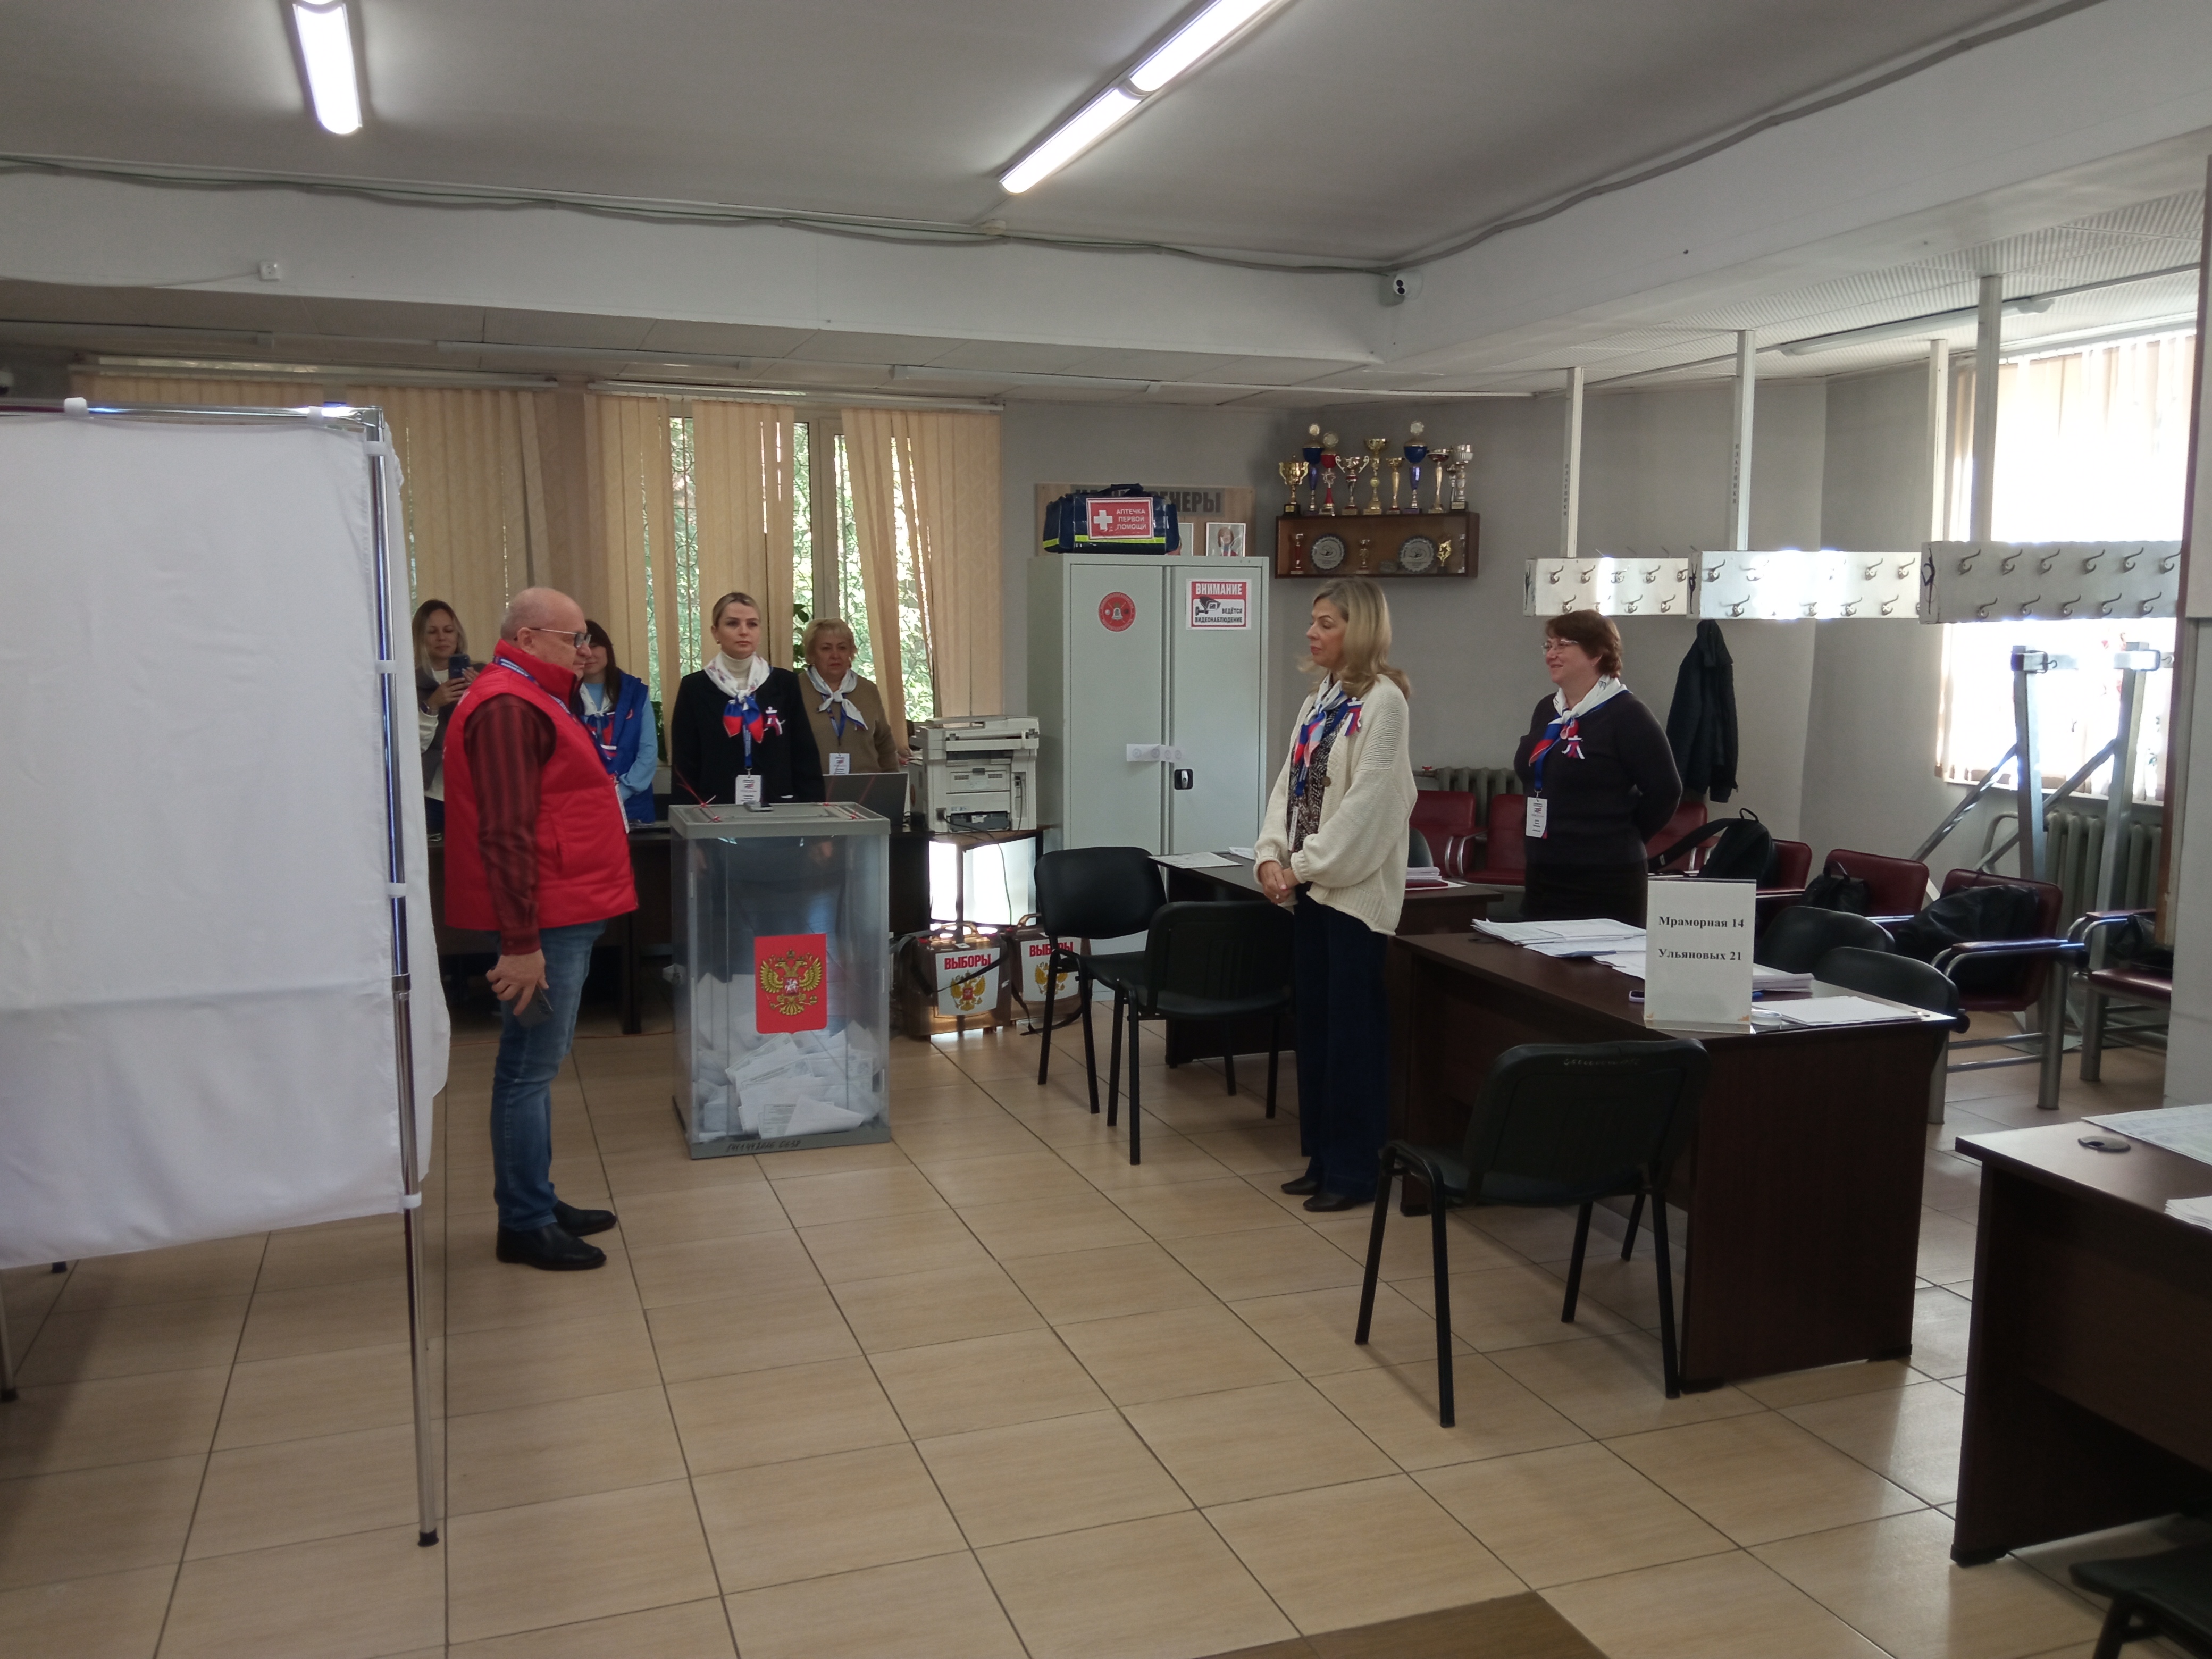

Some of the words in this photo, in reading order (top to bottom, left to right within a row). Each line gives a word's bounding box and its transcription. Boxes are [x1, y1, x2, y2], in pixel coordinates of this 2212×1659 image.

[1195, 583, 1243, 595] ВНИМАНИЕ
[1658, 916, 1728, 928] Мраморная
[1732, 918, 1744, 927] 14
[1029, 942, 1073, 957] ВЫБРЫ
[1658, 949, 1726, 960] Ульяновых
[1729, 951, 1741, 961] 21
[944, 954, 991, 970] ВЫБОРЫ
